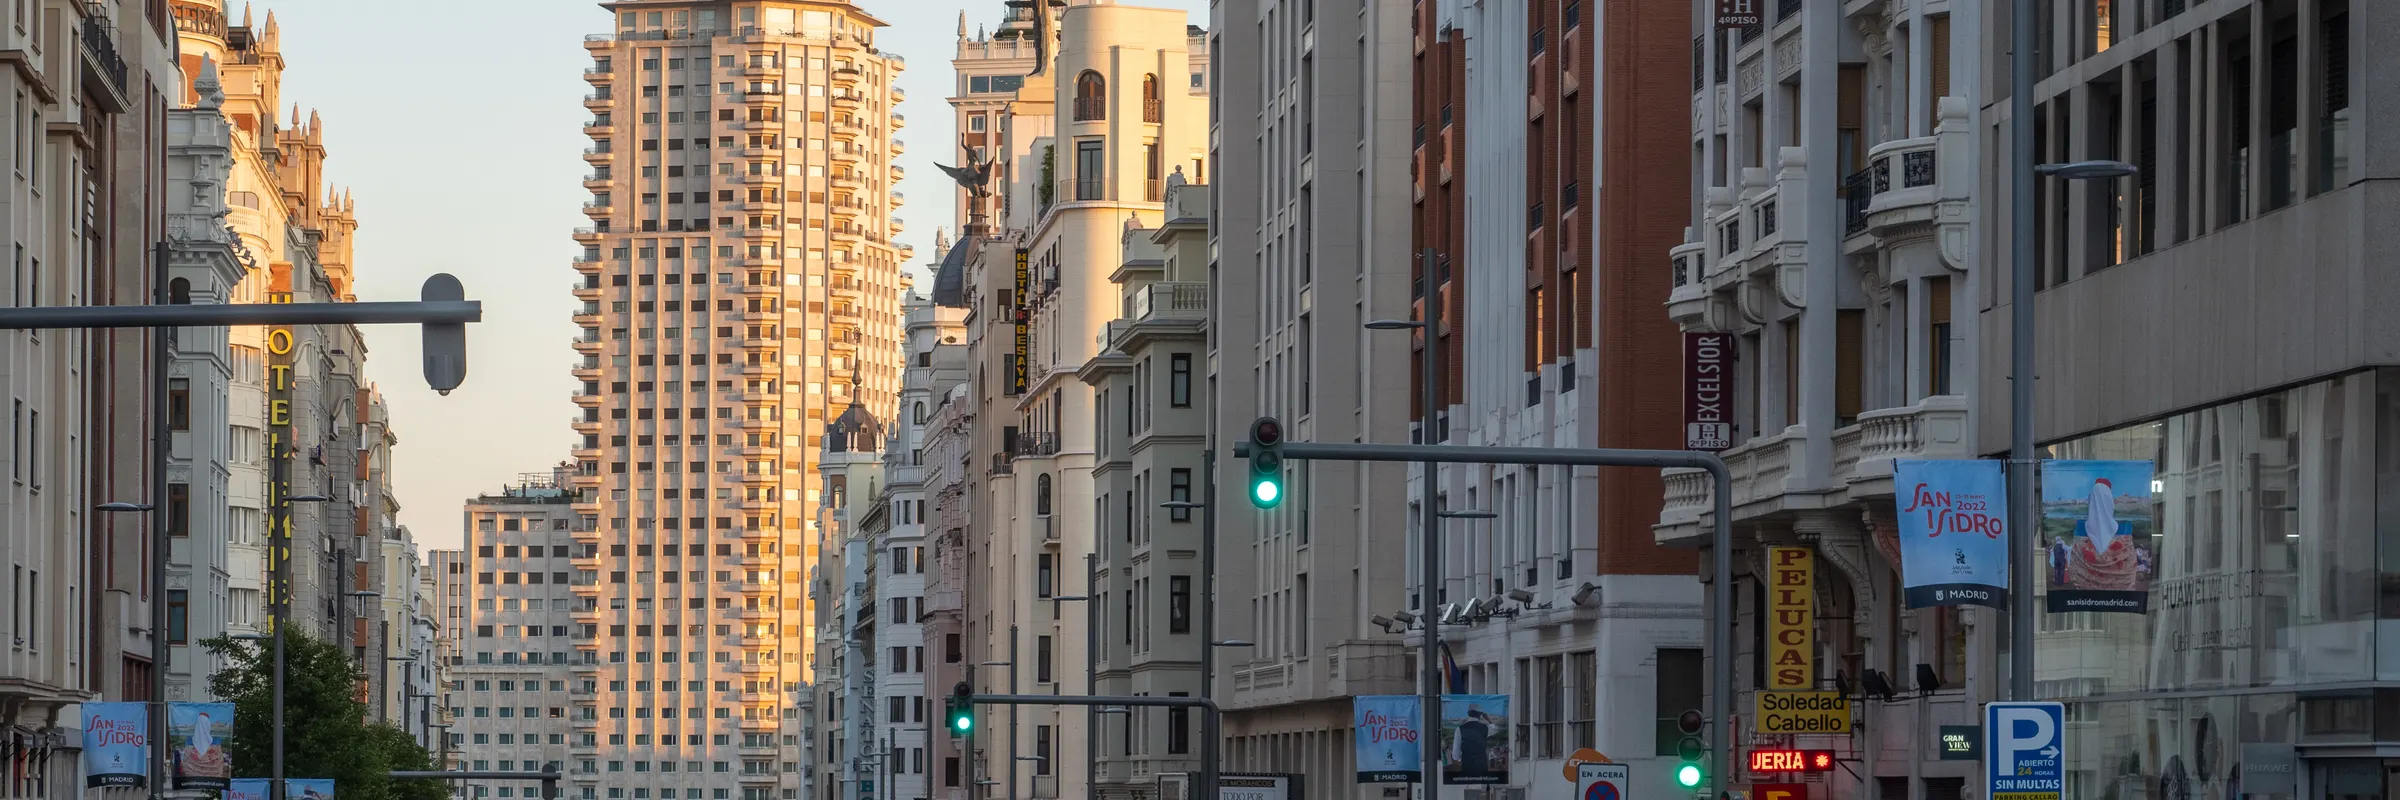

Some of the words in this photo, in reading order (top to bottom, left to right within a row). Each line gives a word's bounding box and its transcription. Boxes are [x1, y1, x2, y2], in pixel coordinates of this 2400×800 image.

[1016, 253, 1027, 306] HOSTAL
[1016, 325, 1027, 387] BESAYA
[1697, 335, 1721, 422] EXCELSIOR
[1905, 483, 1951, 513] SAN
[1956, 500, 1987, 511] 2022
[1927, 508, 2003, 540] ISIDRO
[1949, 590, 1989, 600] MADRID
[2066, 598, 2139, 608] sanisidromadrid.com
[2162, 578, 2205, 610] HUAWEI
[1775, 550, 1808, 686] PELUCAS
[1763, 693, 1845, 711] Soledad
[86, 714, 114, 733] SAN
[859, 669, 875, 772] SENATOR
[1359, 709, 1387, 728] SAN
[1390, 719, 1409, 727] 2022
[1765, 713, 1842, 732] Cabello
[98, 729, 144, 748] ISIDRO
[1371, 725, 1418, 744] ISIDRO
[1943, 734, 1964, 742] GRAN
[1997, 707, 2055, 777] P
[1949, 741, 1971, 749] VIEW
[2017, 767, 2033, 776] 24
[2018, 759, 2055, 767] ABIERTO
[1230, 779, 1273, 787] MORANCOS
[1597, 771, 1624, 779] ACERA
[1995, 780, 2014, 790] SIN
[2016, 779, 2060, 790] MULTAS
[860, 780, 874, 800] H
[1223, 792, 1246, 800] TODO
[1247, 792, 1264, 800] POR
